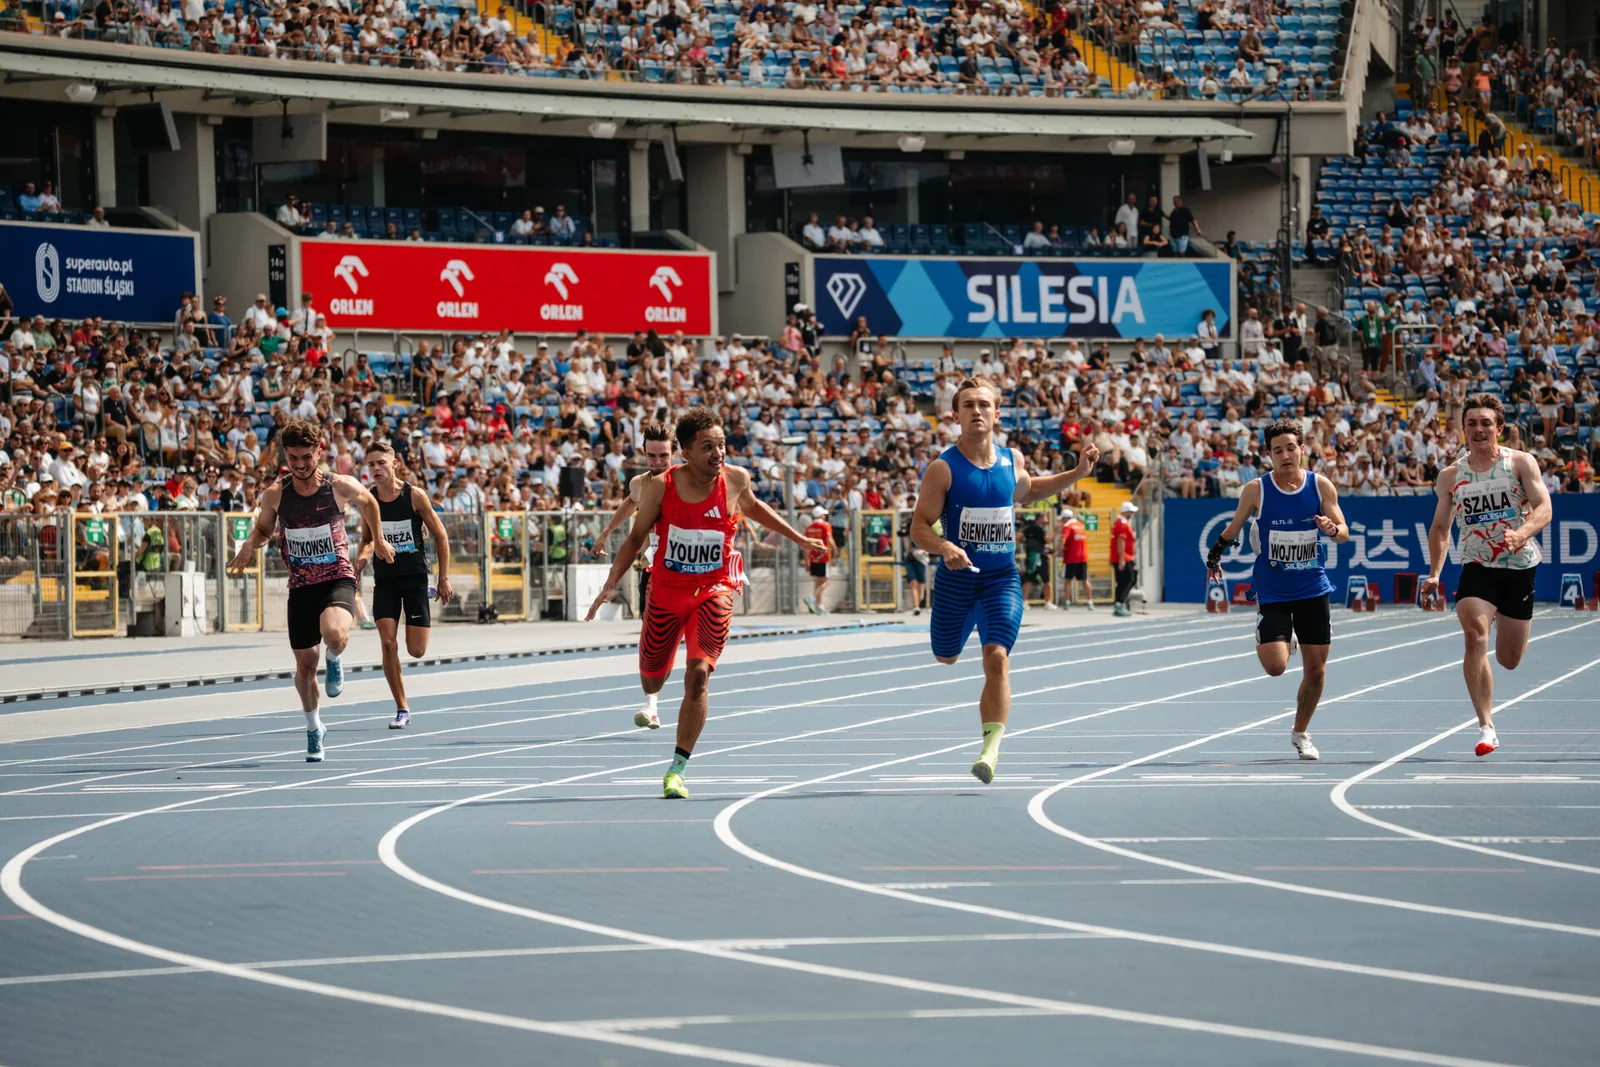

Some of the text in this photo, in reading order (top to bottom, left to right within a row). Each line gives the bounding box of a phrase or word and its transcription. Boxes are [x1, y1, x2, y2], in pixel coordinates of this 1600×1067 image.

[66, 257, 133, 276] superauto.pl
[66, 276, 134, 301] STADION ŚLĄSKI
[330, 298, 374, 316] ORLEN
[967, 275, 1146, 324] SILESIA
[437, 301, 479, 319] ORLEN
[540, 303, 583, 321] ORLEN
[645, 306, 687, 323] ORLEN
[1463, 492, 1512, 515] SZALA
[1478, 511, 1508, 521] SILESIA
[961, 522, 1013, 542] SIENKIEWICZ
[669, 540, 721, 563] YOUNG
[976, 544, 1008, 552] SILESIA
[1271, 542, 1317, 562] WOJTUNIK
[681, 564, 715, 573] SILESIA
[1284, 561, 1312, 570] SILESIA
[1350, 586, 1366, 600] 7
[1564, 585, 1580, 604] 4
